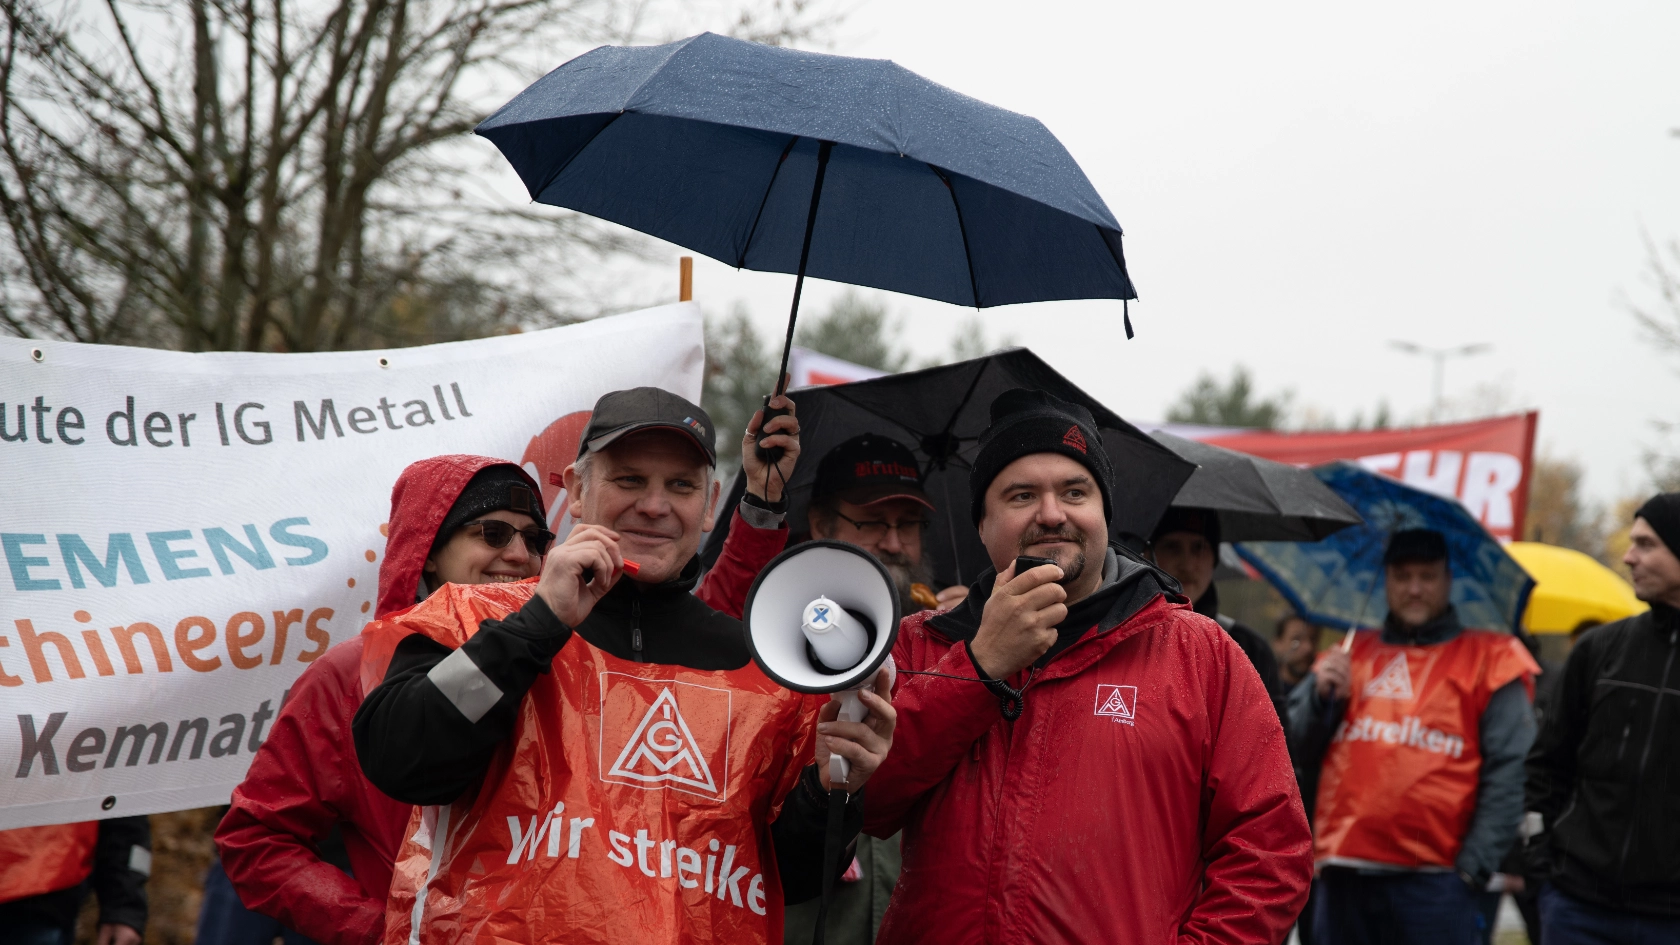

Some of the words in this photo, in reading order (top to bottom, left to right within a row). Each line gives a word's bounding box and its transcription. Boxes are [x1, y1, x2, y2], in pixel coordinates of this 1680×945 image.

[0, 396, 86, 446] ute
[105, 395, 197, 447] der
[214, 401, 273, 447] IG
[293, 381, 474, 442] Metall
[0, 516, 329, 592] EMENS
[15, 688, 290, 778] Kemnat
[607, 828, 767, 916] streike
